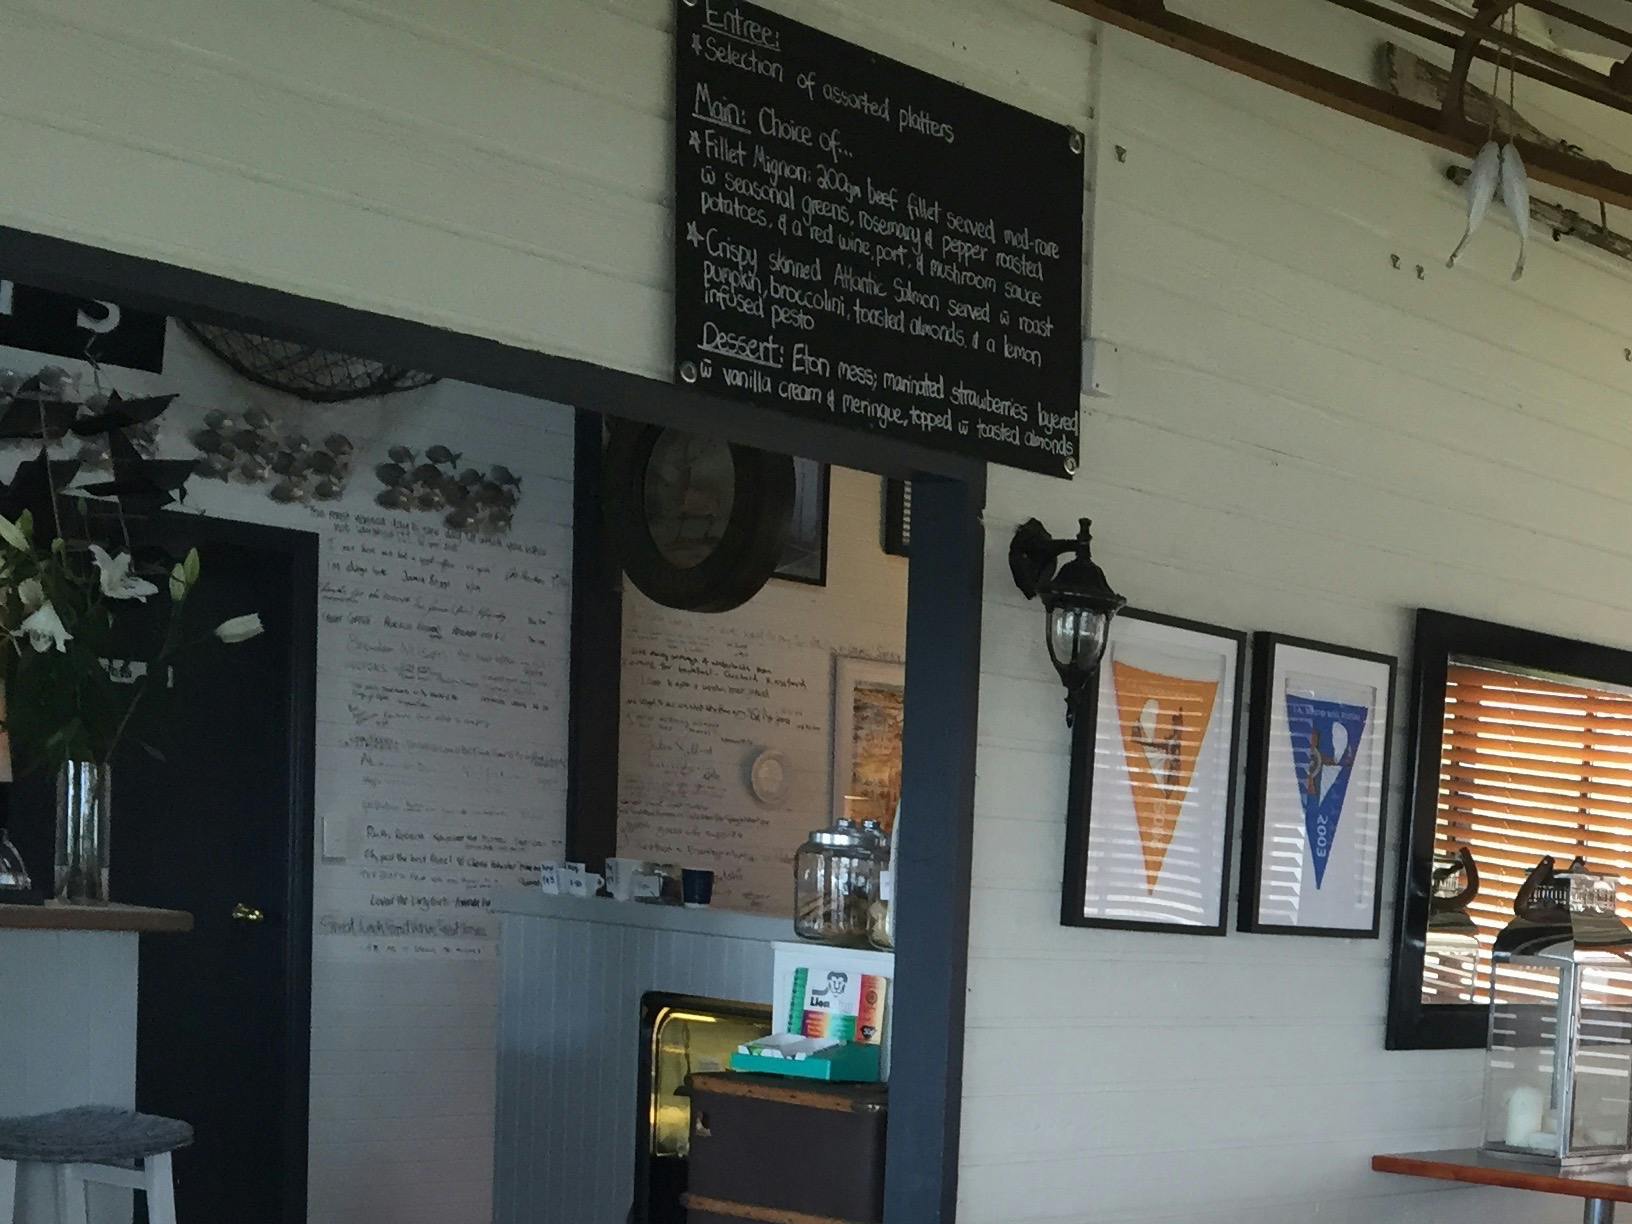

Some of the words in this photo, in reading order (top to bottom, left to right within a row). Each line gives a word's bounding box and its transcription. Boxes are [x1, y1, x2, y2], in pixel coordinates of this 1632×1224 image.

[705, 0, 780, 48] Entree:
[695, 82, 747, 125] Main:
[759, 106, 813, 146] Choice
[704, 37, 783, 82] Selection
[797, 72, 816, 100] of
[823, 84, 890, 121] assorted
[899, 105, 954, 144] platters
[705, 129, 746, 167] Fillet
[753, 145, 812, 187] Mignon:
[867, 176, 898, 211] beef
[907, 193, 942, 223] fillet
[946, 212, 996, 244] served
[724, 172, 795, 211] seasonal
[859, 210, 921, 254] rosemary
[943, 235, 988, 266] pepper
[996, 251, 1043, 281] roasted
[705, 227, 758, 277] Crispy
[768, 248, 822, 281] skinned
[833, 263, 888, 297] Atlantic
[893, 277, 939, 312] Salmon
[947, 299, 991, 323] served
[1019, 316, 1054, 337] roast
[791, 219, 803, 237] a
[810, 223, 833, 245] red
[929, 259, 997, 293] mushroom
[1004, 281, 1042, 307] sauce
[705, 285, 764, 318] infused
[771, 304, 815, 330] pesto
[853, 298, 904, 334] toasted
[985, 338, 996, 354] a
[1004, 334, 1041, 367] lemon
[702, 321, 784, 364] Dessert:
[792, 343, 830, 377] Eton
[884, 372, 944, 400] marinated
[950, 381, 1028, 422] strawberries
[1037, 401, 1079, 437] layered
[722, 367, 772, 394] vanilla
[779, 381, 822, 404] cream
[910, 406, 953, 432] topped
[977, 418, 1020, 446] toasted
[1024, 428, 1075, 457] almonds
[1316, 813, 1329, 859] 2003
[810, 996, 830, 1009] Lion
